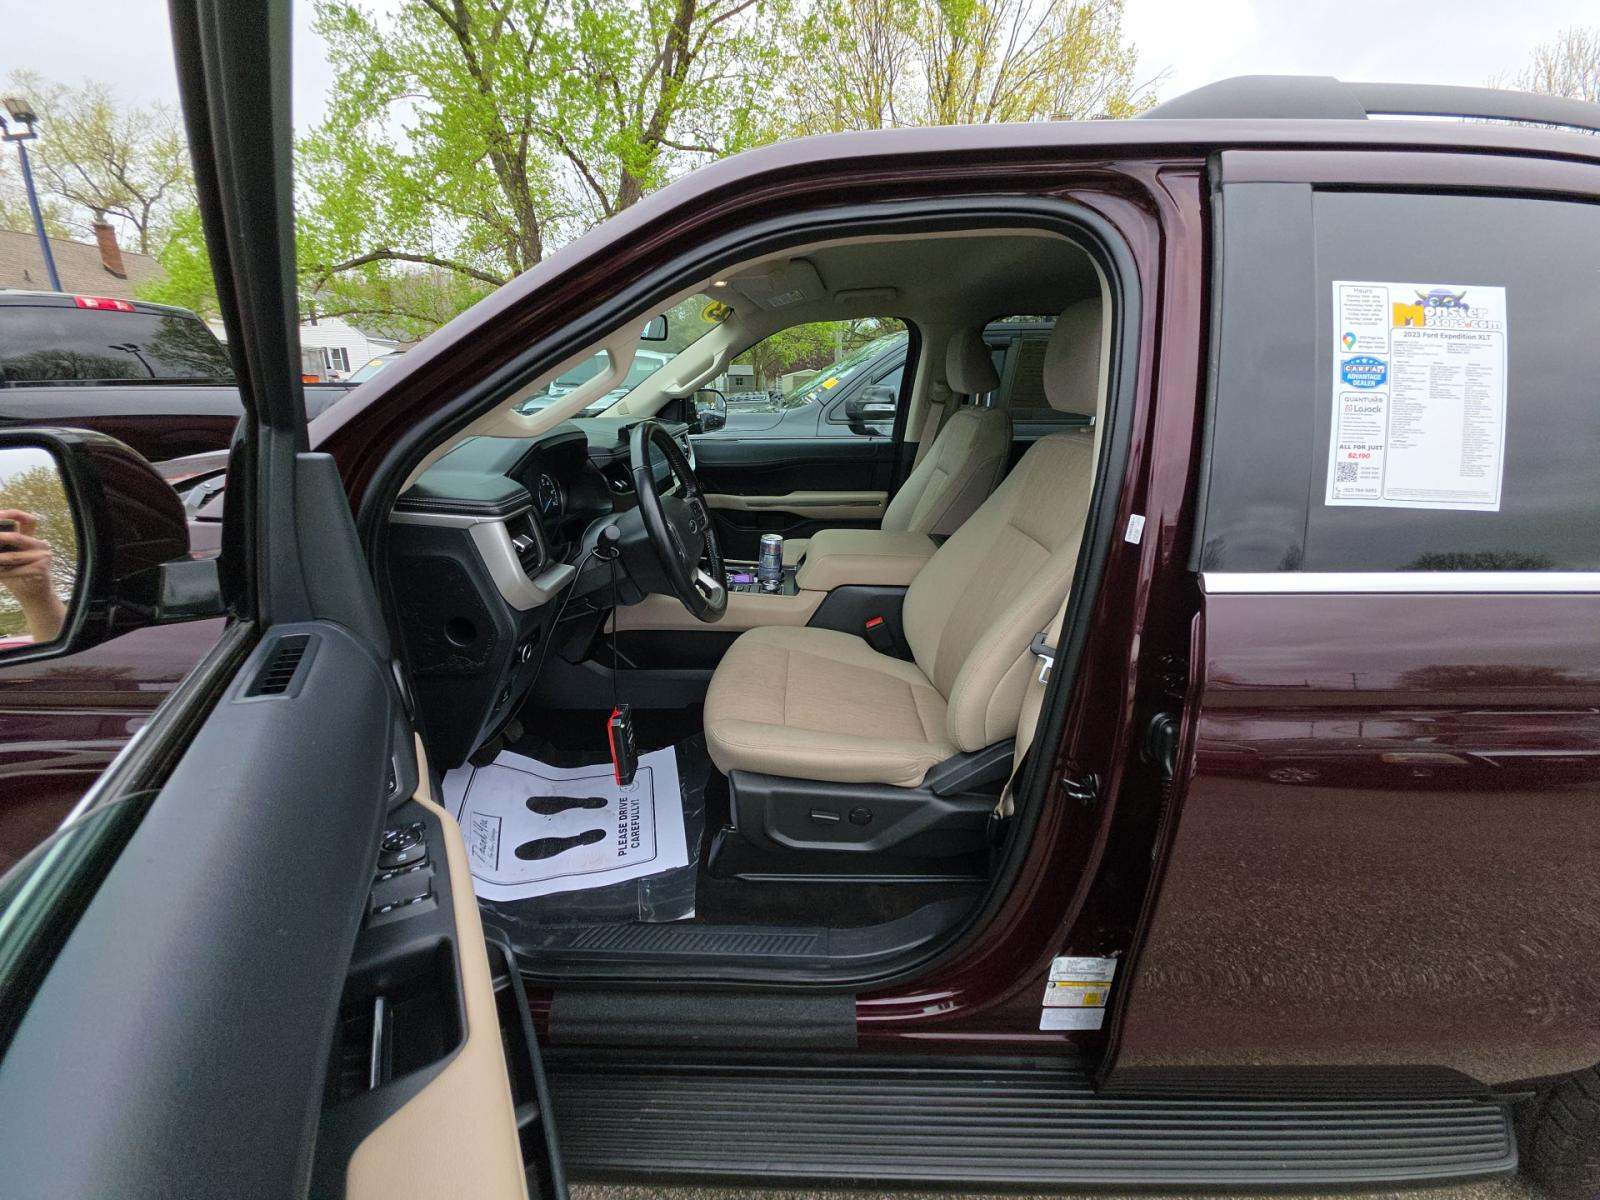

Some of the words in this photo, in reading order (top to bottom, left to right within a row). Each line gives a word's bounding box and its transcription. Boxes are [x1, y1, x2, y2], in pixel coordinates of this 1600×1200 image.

[1440, 332, 1477, 341] Expedition
[1344, 365, 1385, 374] CARFAX
[1347, 373, 1382, 381] ADVANTAGE
[1352, 379, 1376, 387] DEALER
[618, 797, 628, 821] DRIVE
[630, 799, 640, 849] CAREFULLY!
[617, 822, 628, 857] PLEASE
